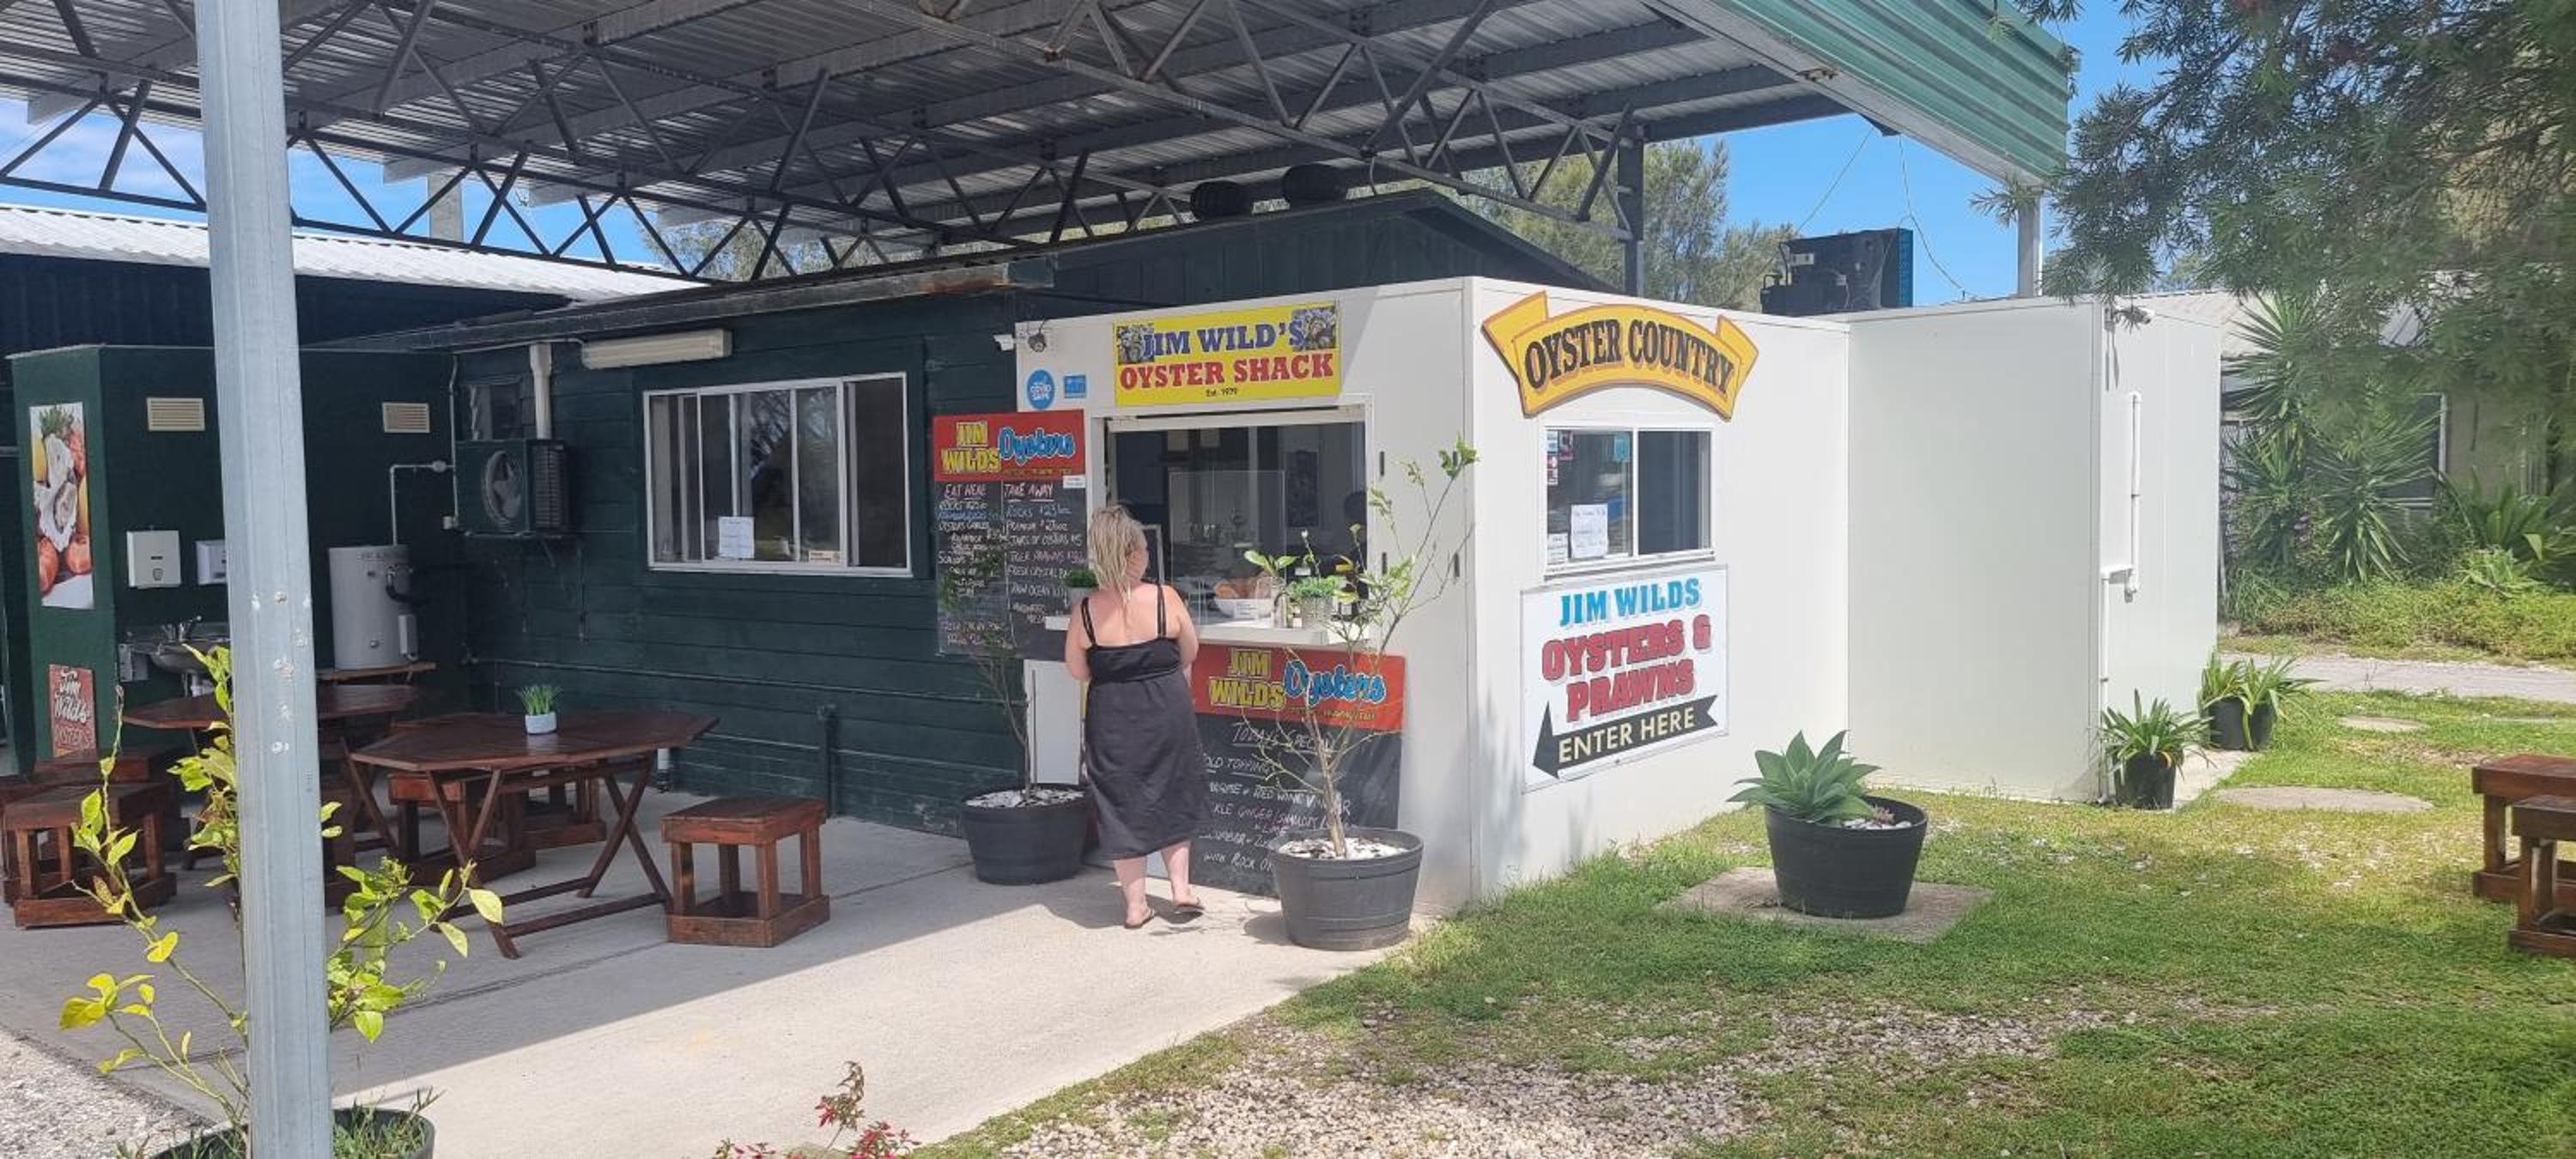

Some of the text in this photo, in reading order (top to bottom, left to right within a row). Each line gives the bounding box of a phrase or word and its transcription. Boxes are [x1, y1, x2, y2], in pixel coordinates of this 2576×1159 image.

[1143, 319, 1305, 358] JIM WILD'S
[1525, 319, 1735, 395] OYSTER COUNTRY
[1120, 361, 1225, 390] OYSTER
[1234, 353, 1334, 384] SHACK
[941, 447, 1002, 474] WILDS
[957, 421, 1076, 466] JIM Oysters
[1004, 482, 1054, 498] TAKE AWAY
[1559, 577, 1701, 627] JIM WILDS
[1541, 618, 1686, 682] OYSTERS
[1209, 677, 1286, 711] WILDS
[1228, 649, 1387, 707] JIM Oysters
[1566, 658, 1696, 724] PRAWNS
[1558, 707, 1696, 763] ENTER HERE
